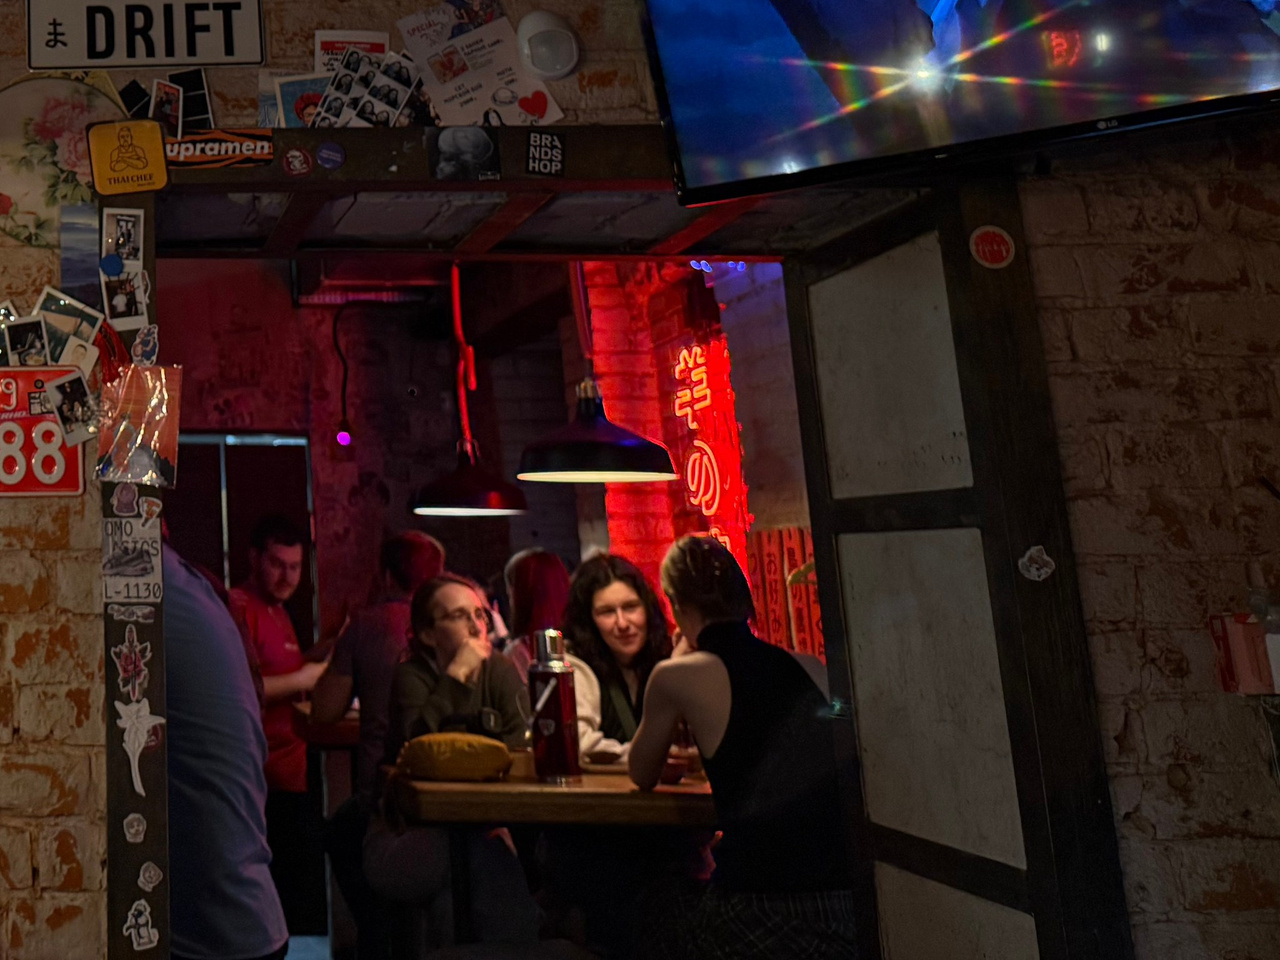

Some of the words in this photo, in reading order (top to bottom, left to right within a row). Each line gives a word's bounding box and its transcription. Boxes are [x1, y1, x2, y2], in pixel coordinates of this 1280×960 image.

[45, 17, 68, 48] ま
[86, 1, 242, 60] DRIFT
[166, 139, 270, 161] upramen
[528, 159, 562, 174] HOP
